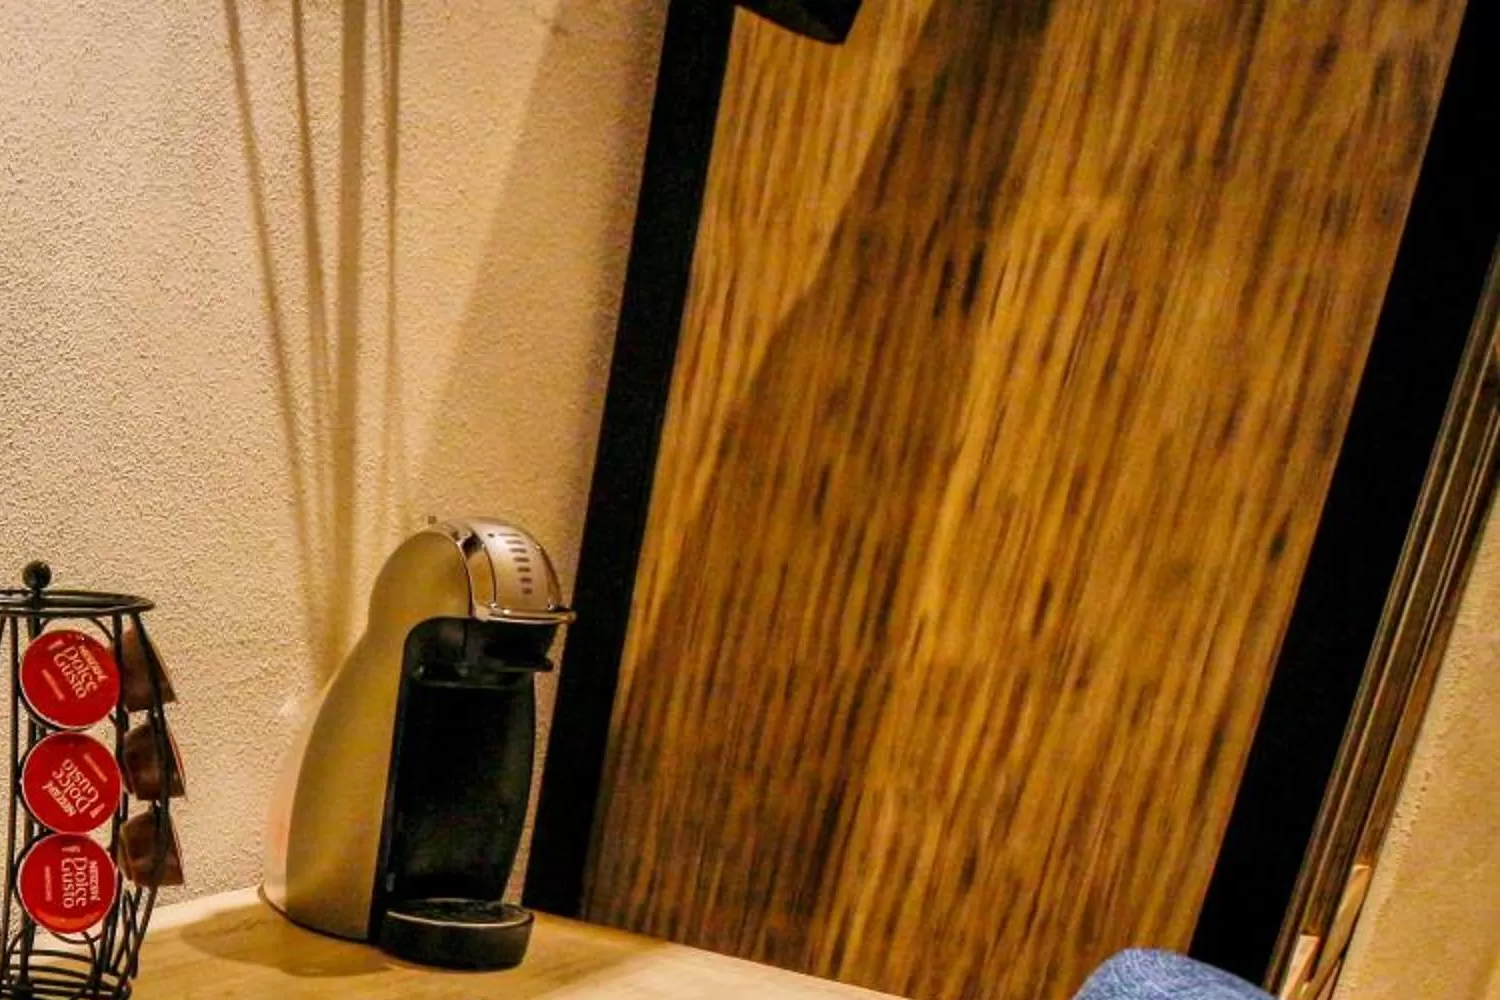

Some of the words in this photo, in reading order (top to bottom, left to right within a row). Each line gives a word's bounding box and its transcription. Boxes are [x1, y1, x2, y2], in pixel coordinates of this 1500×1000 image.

[53, 652, 88, 699] Gusto
[63, 646, 99, 694] Dolce
[52, 767, 92, 814] Dolce
[62, 757, 99, 802] Gusto
[60, 858, 76, 909] Gusto
[73, 856, 88, 907] Dolce
